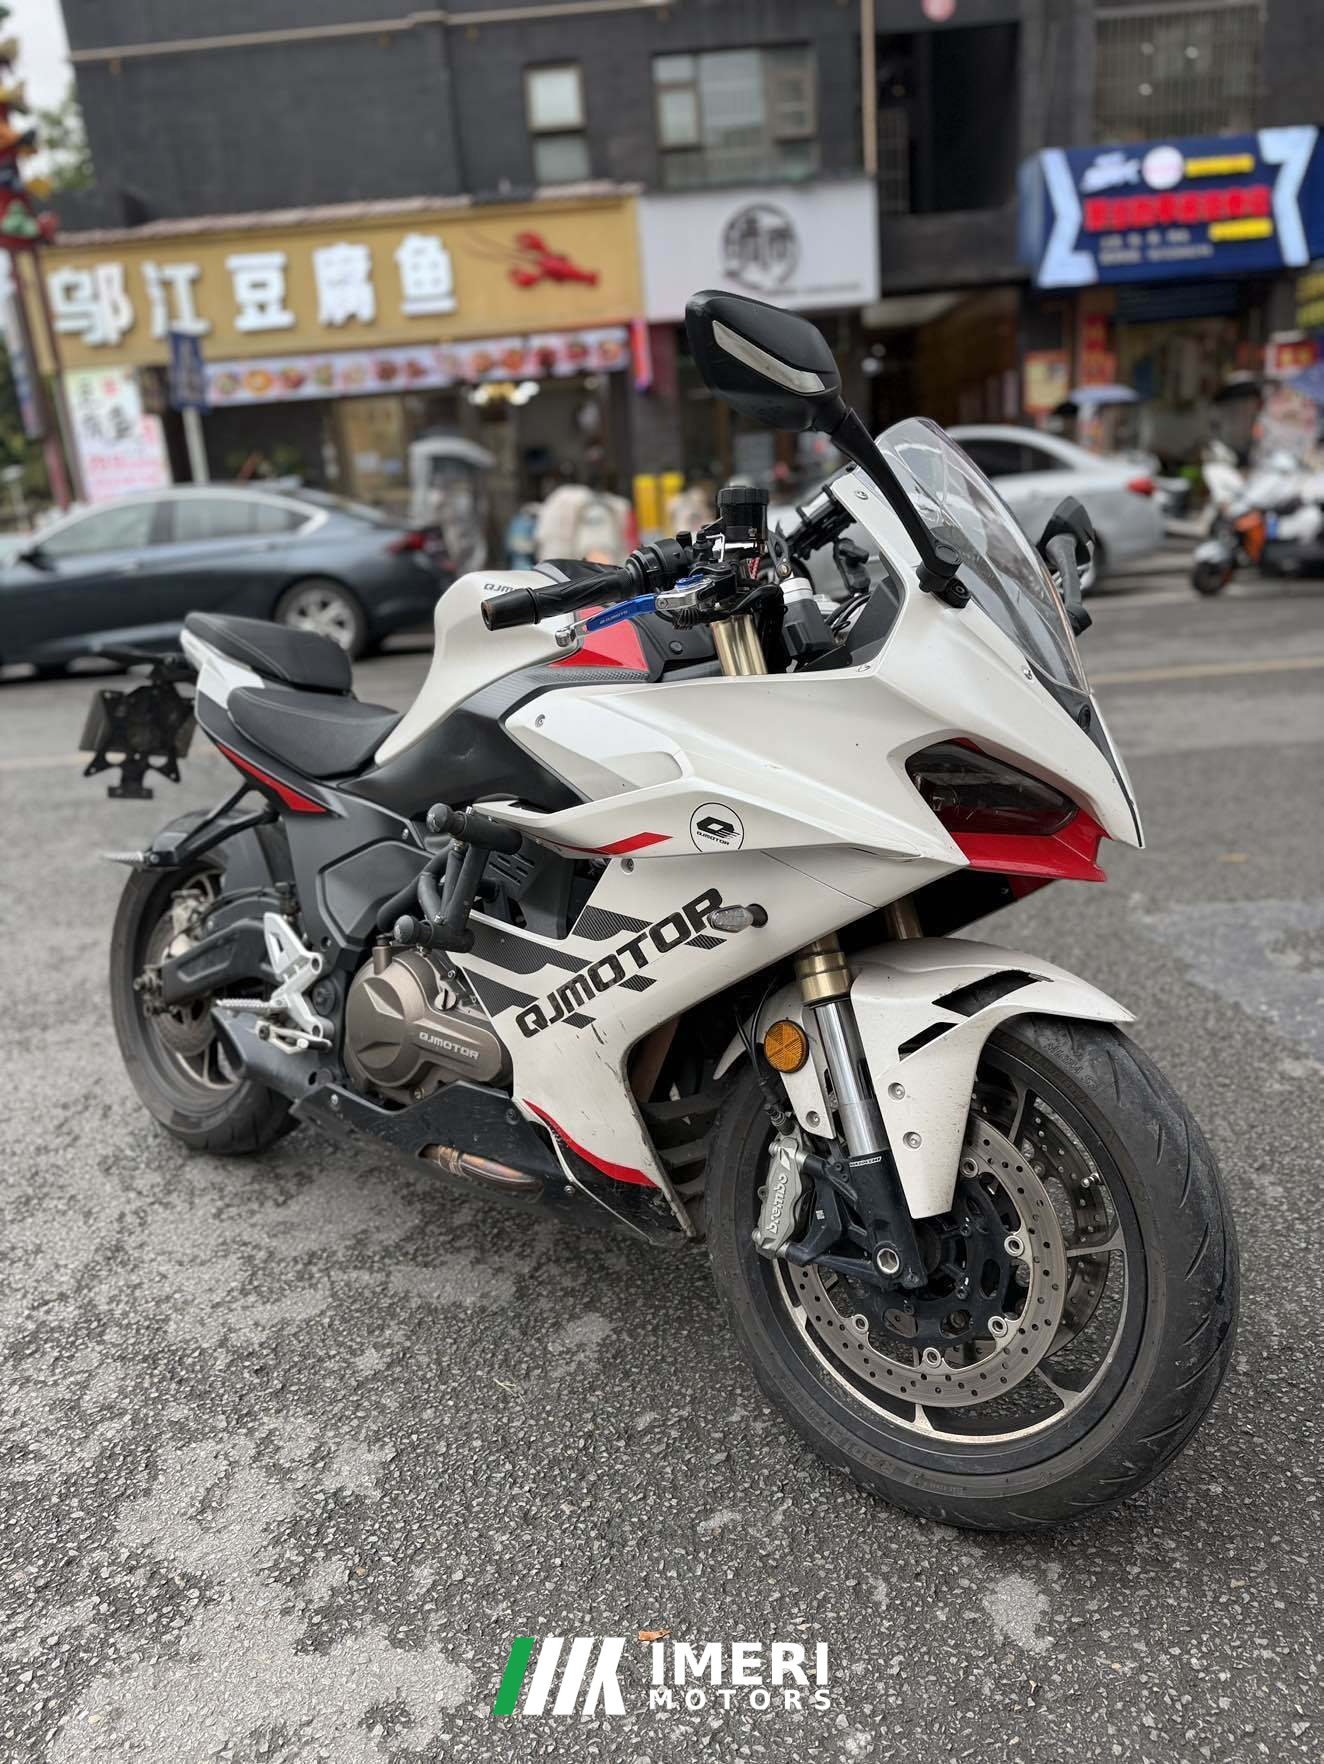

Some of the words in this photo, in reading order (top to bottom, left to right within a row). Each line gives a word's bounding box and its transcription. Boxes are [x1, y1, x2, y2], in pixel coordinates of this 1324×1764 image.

[515, 888, 723, 1039] QJMOTOR
[419, 1031, 479, 1060] QJMOTOR
[766, 1174, 788, 1234] brembo
